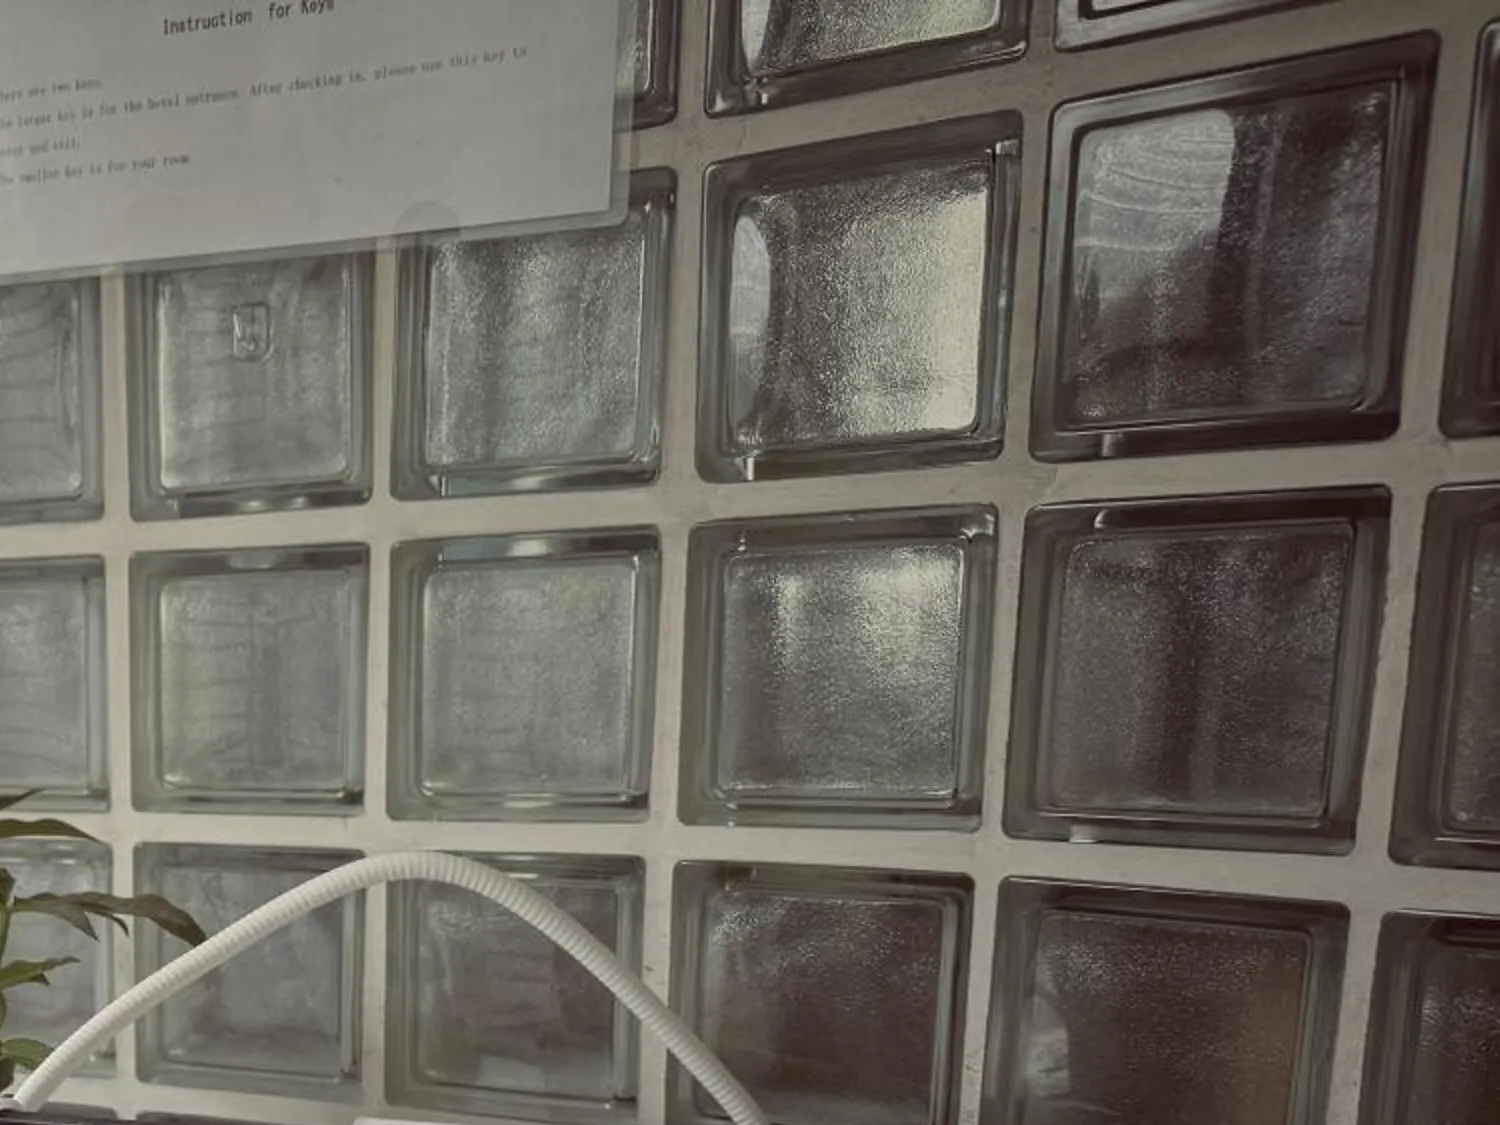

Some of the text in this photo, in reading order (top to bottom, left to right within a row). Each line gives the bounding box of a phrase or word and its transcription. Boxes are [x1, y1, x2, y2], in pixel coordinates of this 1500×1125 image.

[163, 9, 253, 36] Instruction
[268, 1, 292, 21] for
[100, 103, 118, 115] for
[124, 100, 143, 113] the
[250, 82, 282, 97] After
[289, 74, 343, 93] checking
[373, 66, 416, 82] please
[421, 61, 444, 73] use
[449, 52, 478, 68] this
[483, 49, 506, 64] key
[512, 46, 528, 59] to
